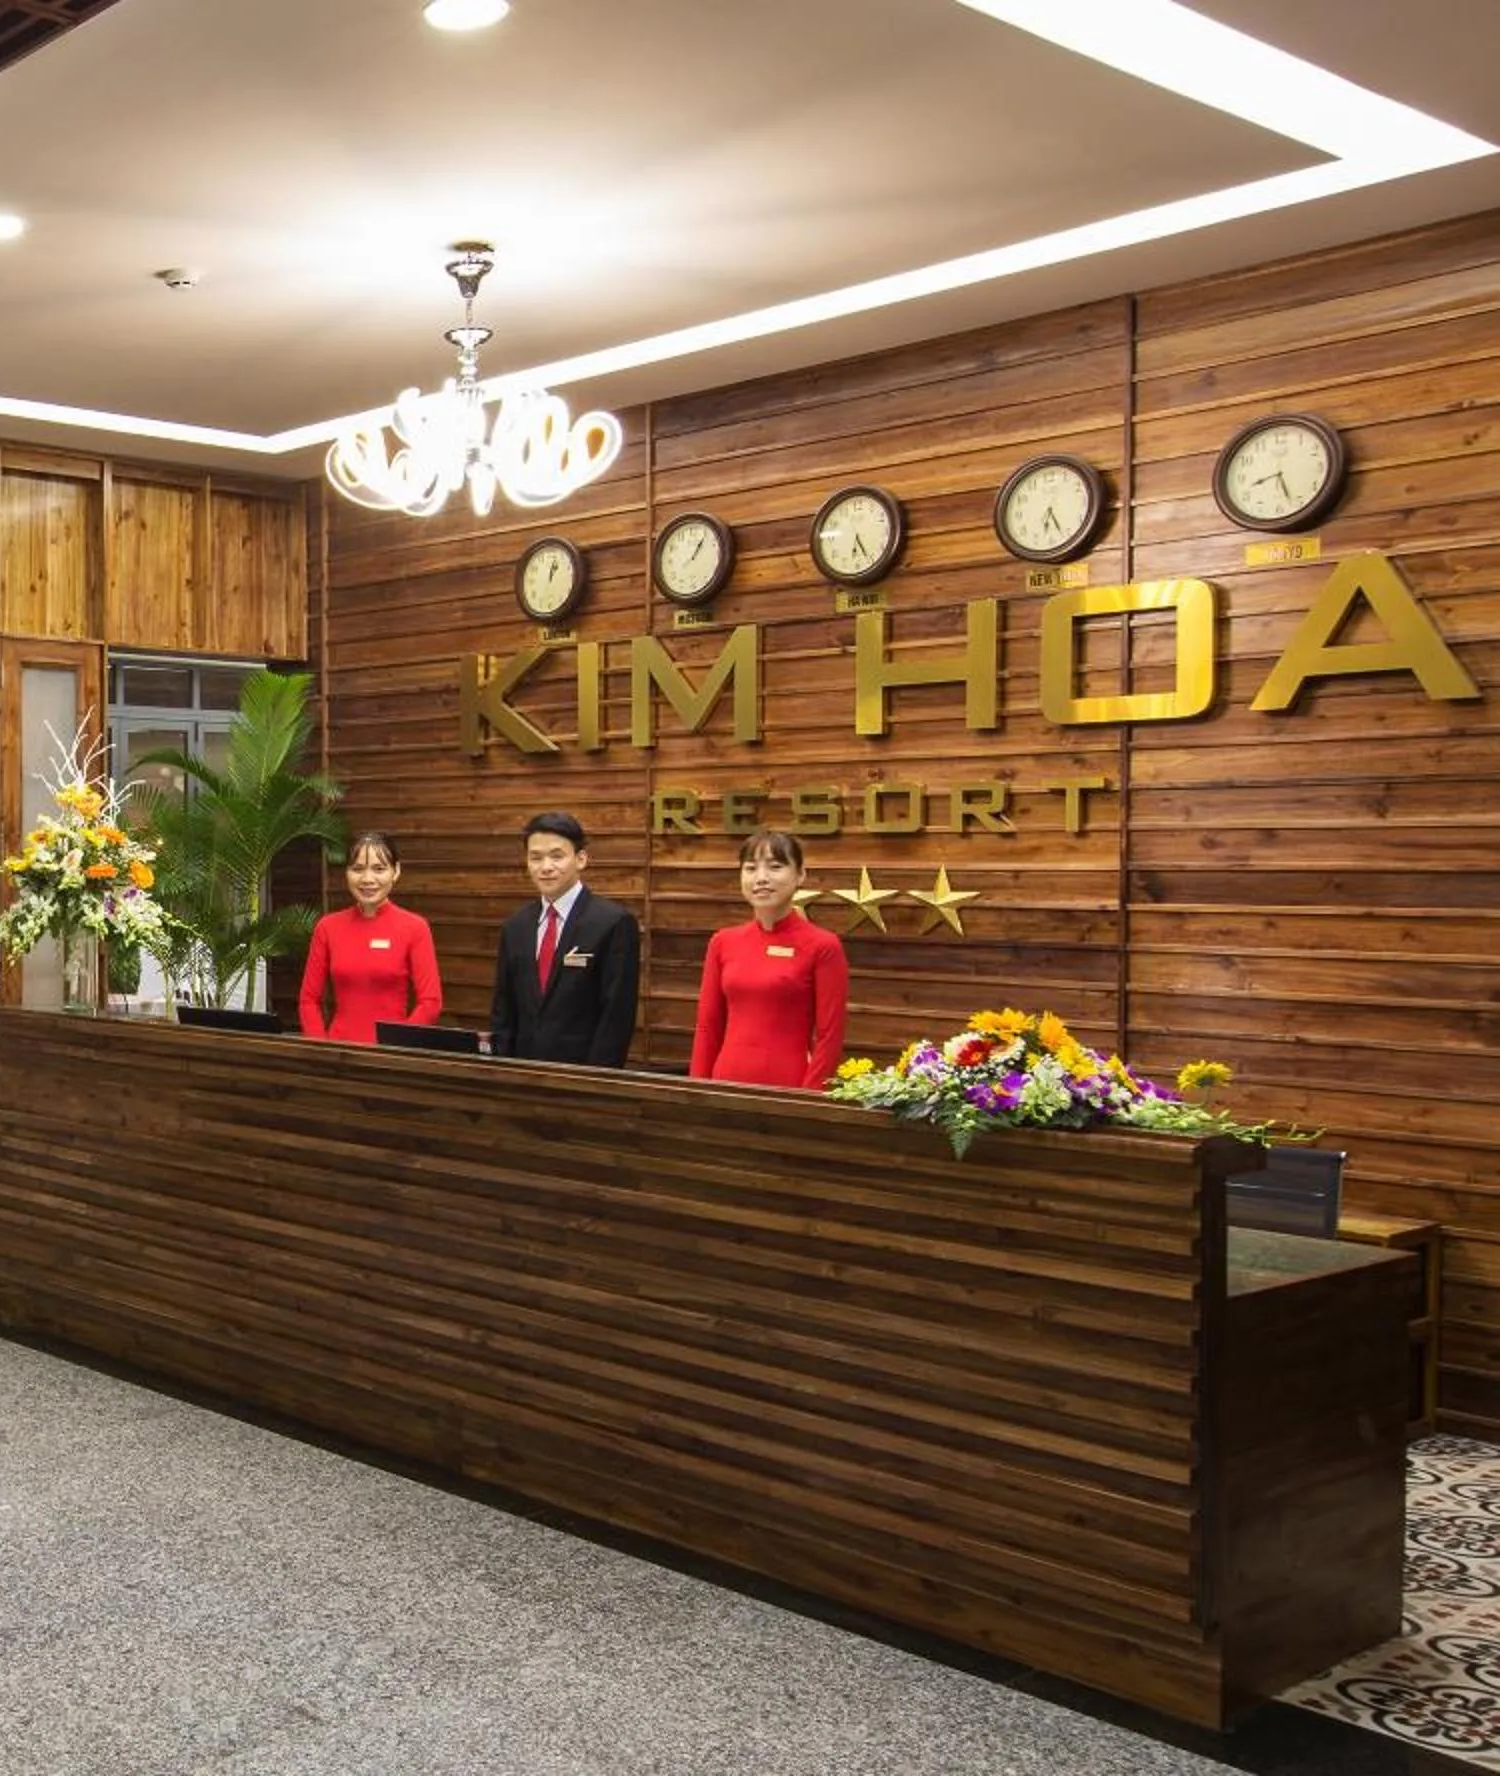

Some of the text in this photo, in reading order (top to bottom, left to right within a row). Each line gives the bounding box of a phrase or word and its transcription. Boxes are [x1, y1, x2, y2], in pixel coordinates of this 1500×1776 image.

[458, 550, 1481, 757] KIM HOA
[652, 775, 1110, 835] RESORT
